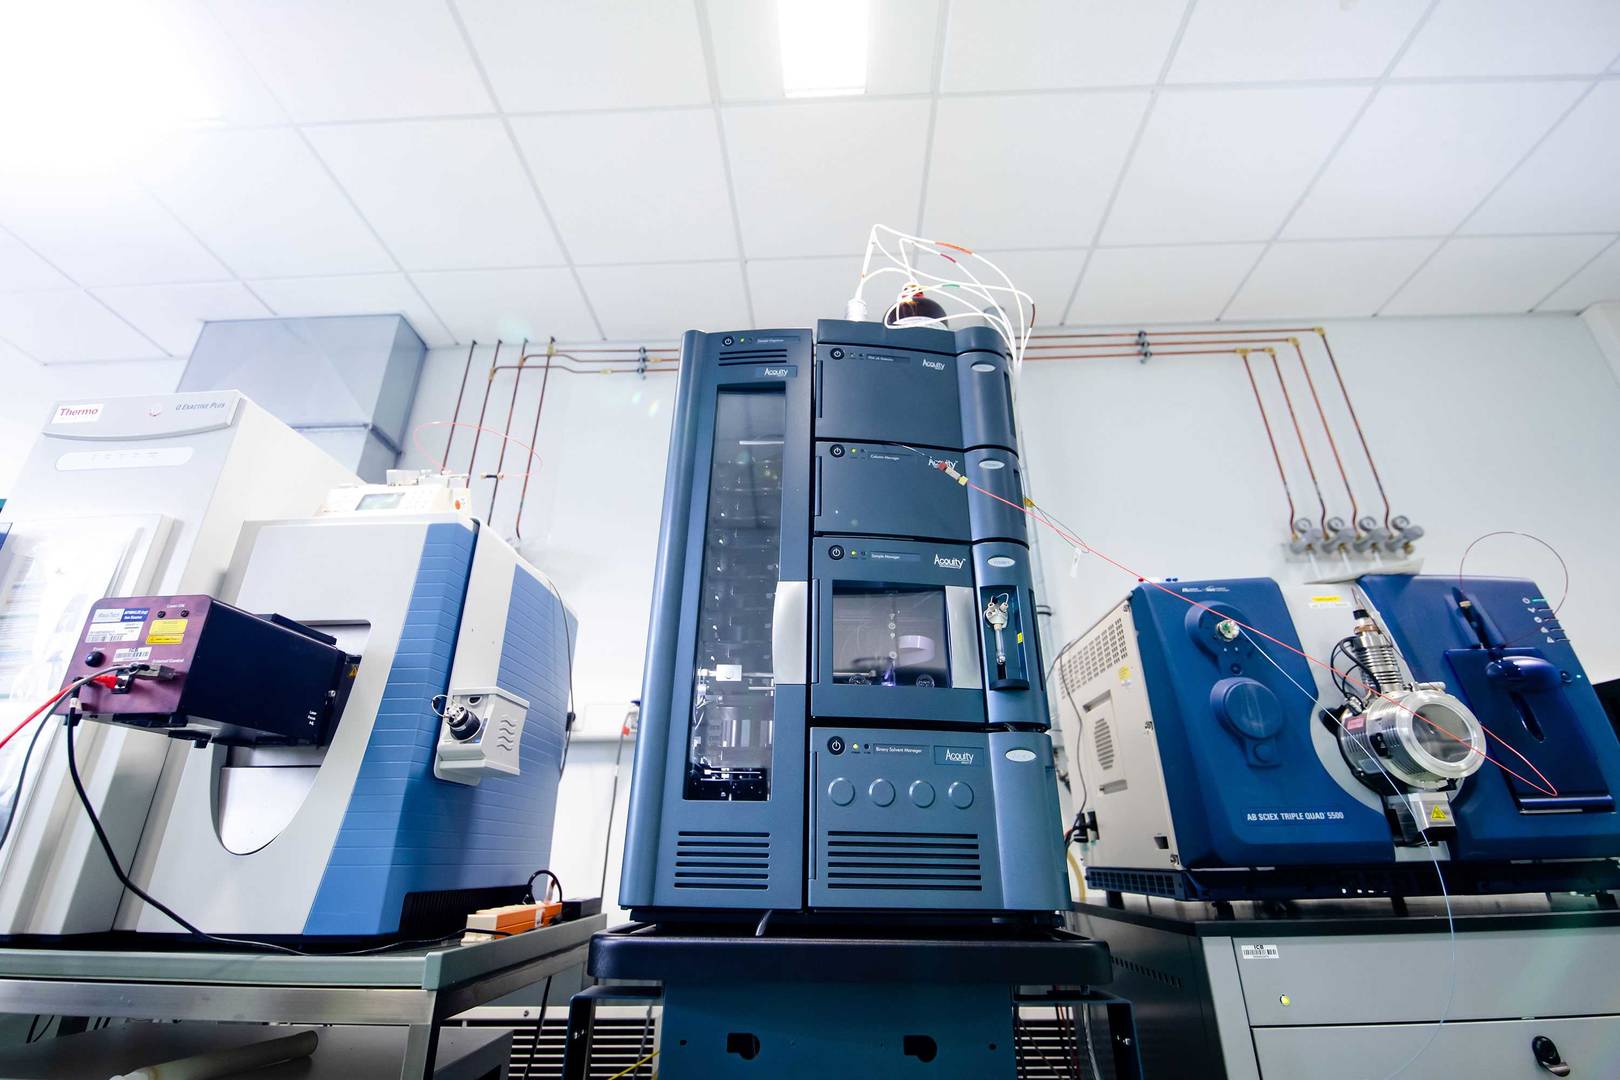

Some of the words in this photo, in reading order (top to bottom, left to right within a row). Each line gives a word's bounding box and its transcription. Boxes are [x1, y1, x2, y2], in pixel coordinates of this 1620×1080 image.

[922, 358, 945, 370] Acquity
[764, 367, 789, 377] Acquity
[60, 407, 99, 416] Thermo
[934, 553, 964, 569] Acquity
[945, 748, 974, 765] Acquity
[1247, 813, 1258, 821] AB
[1258, 813, 1279, 821] SCIEX
[1280, 812, 1305, 820] TRIPLE
[1305, 812, 1325, 820] QUAD
[1327, 811, 1344, 819] 5500
